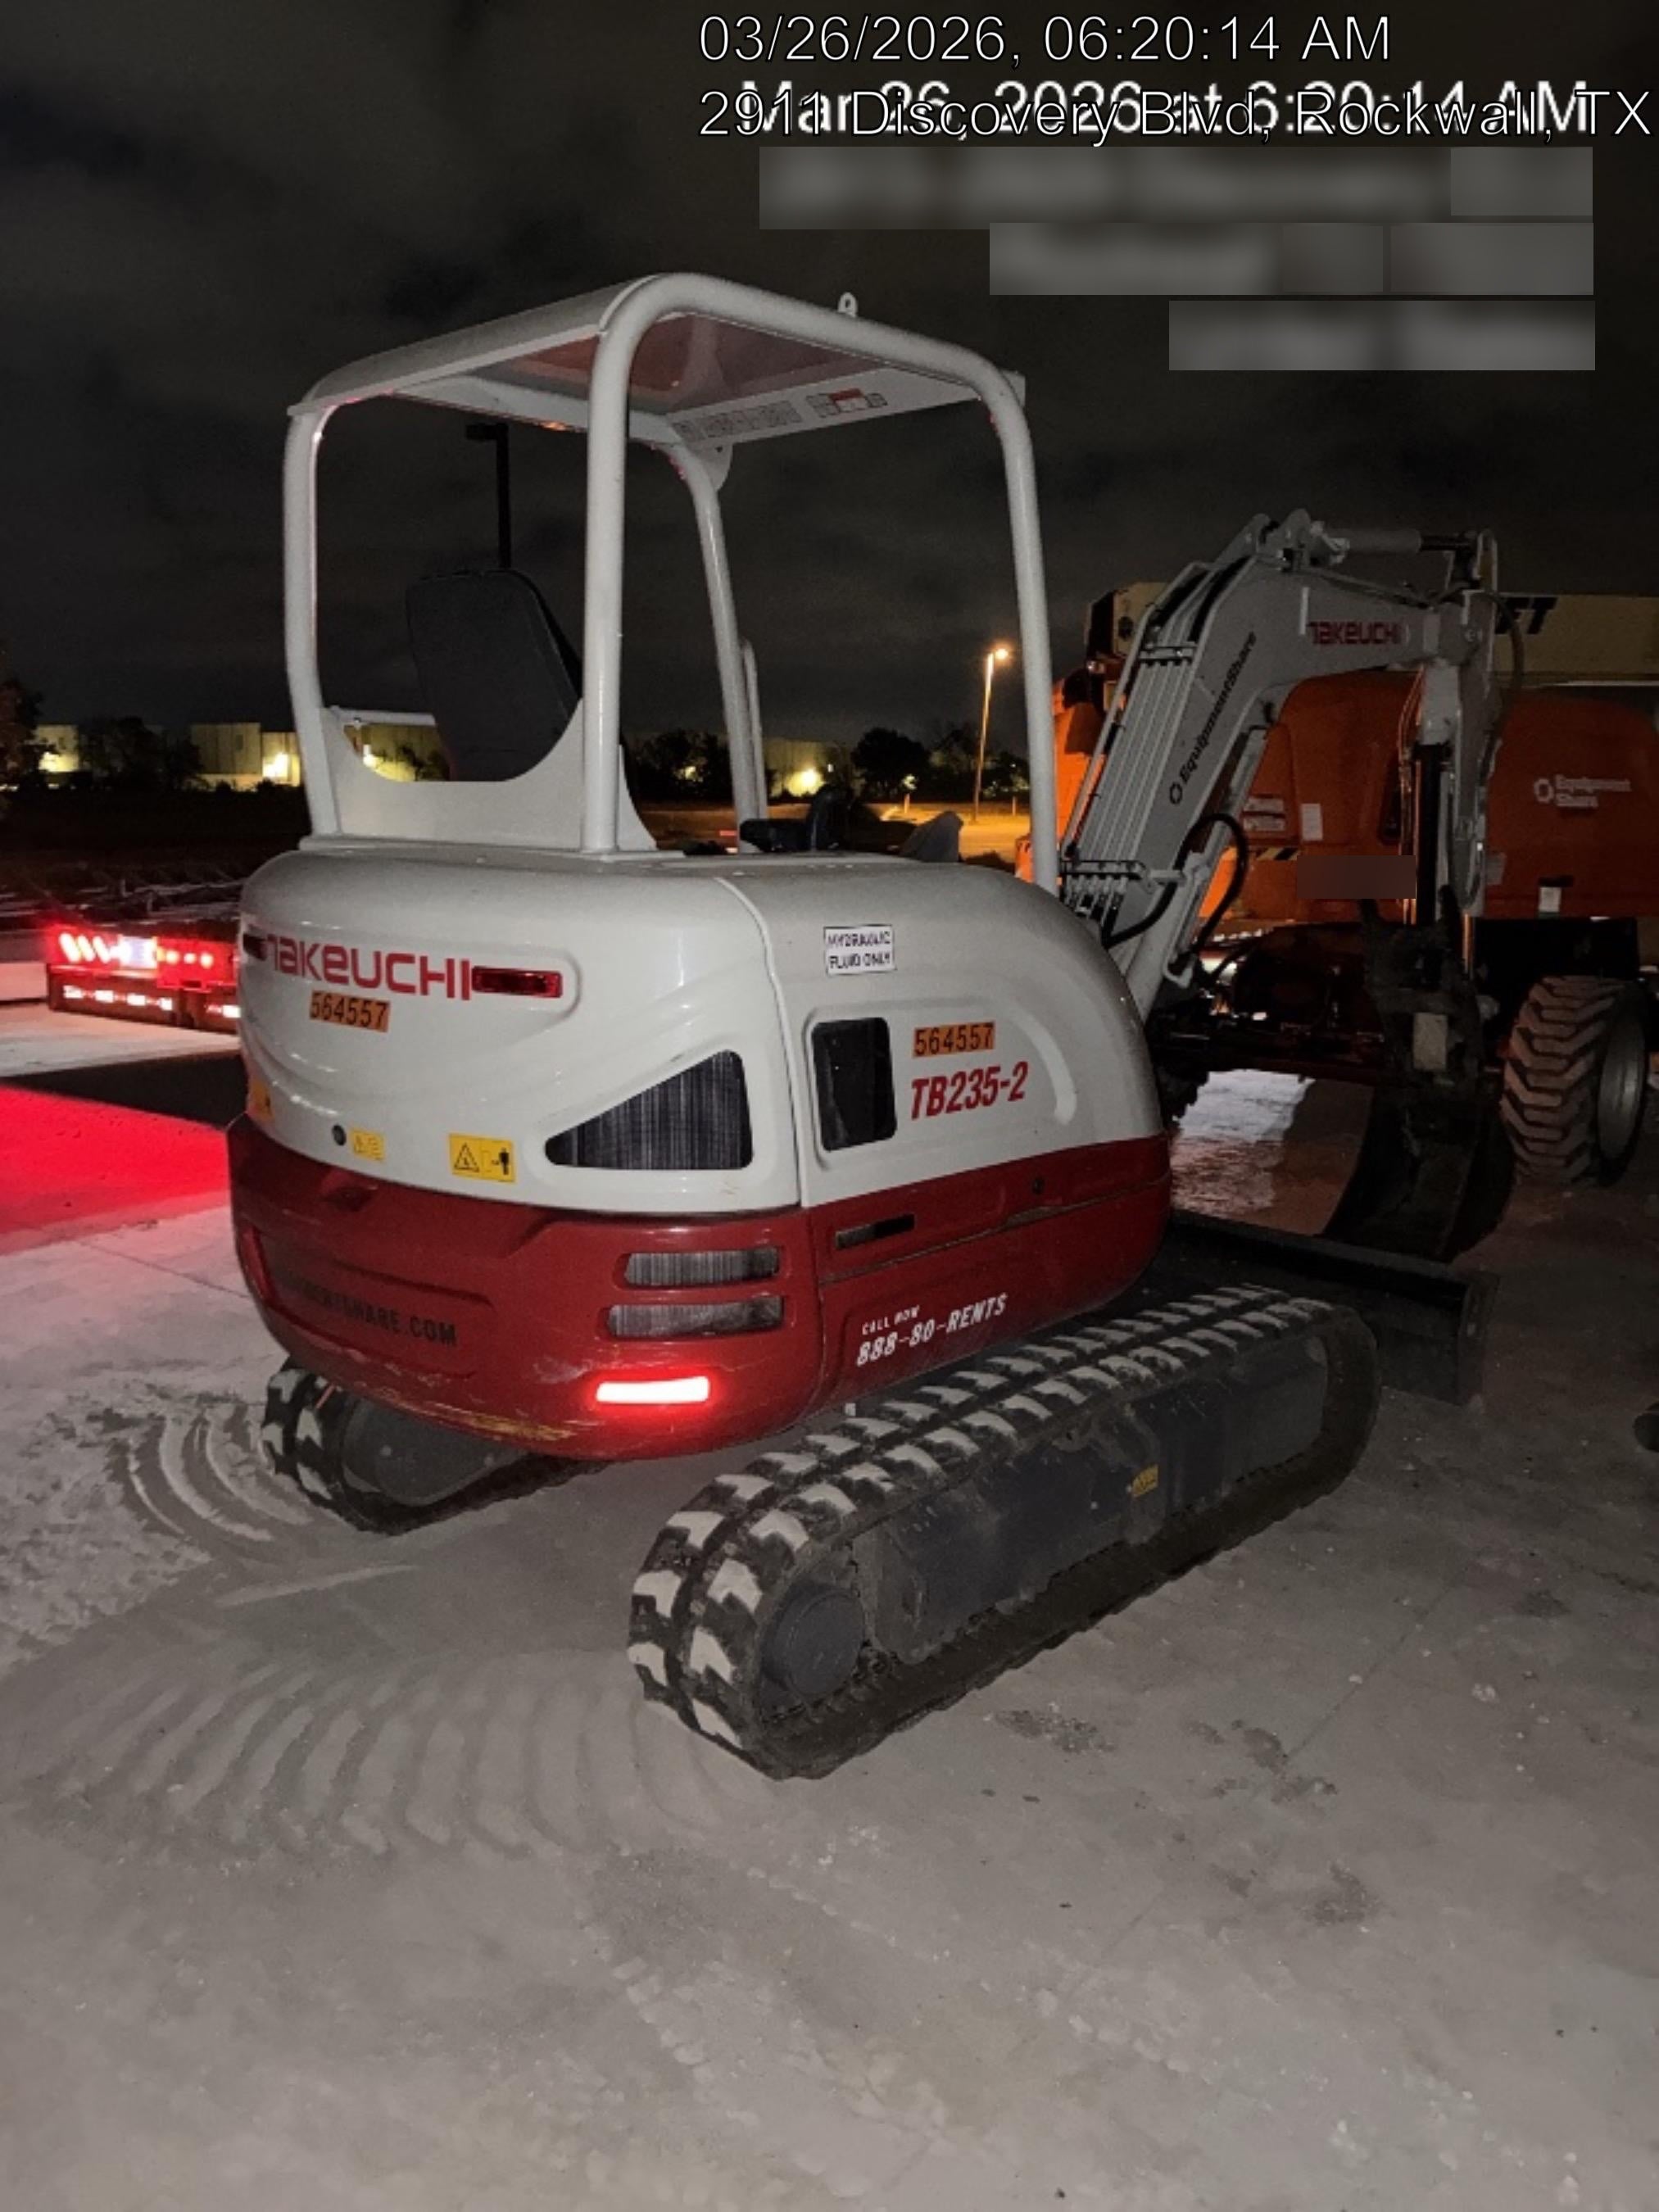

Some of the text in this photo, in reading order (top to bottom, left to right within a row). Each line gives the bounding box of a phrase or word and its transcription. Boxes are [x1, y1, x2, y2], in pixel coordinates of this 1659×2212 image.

[1306, 621, 1402, 646] TAKEUCHI
[827, 929, 891, 948] HYDRAULIC
[266, 933, 471, 1001] TAKEUCHI
[828, 951, 891, 969] FLUID ONLY
[310, 990, 389, 1031] 564557
[913, 1022, 995, 1056] 564557
[911, 1060, 1029, 1121] TB235-2
[856, 1292, 1009, 1368] 888-80-RENTS
[862, 1304, 920, 1335] CALL NOW
